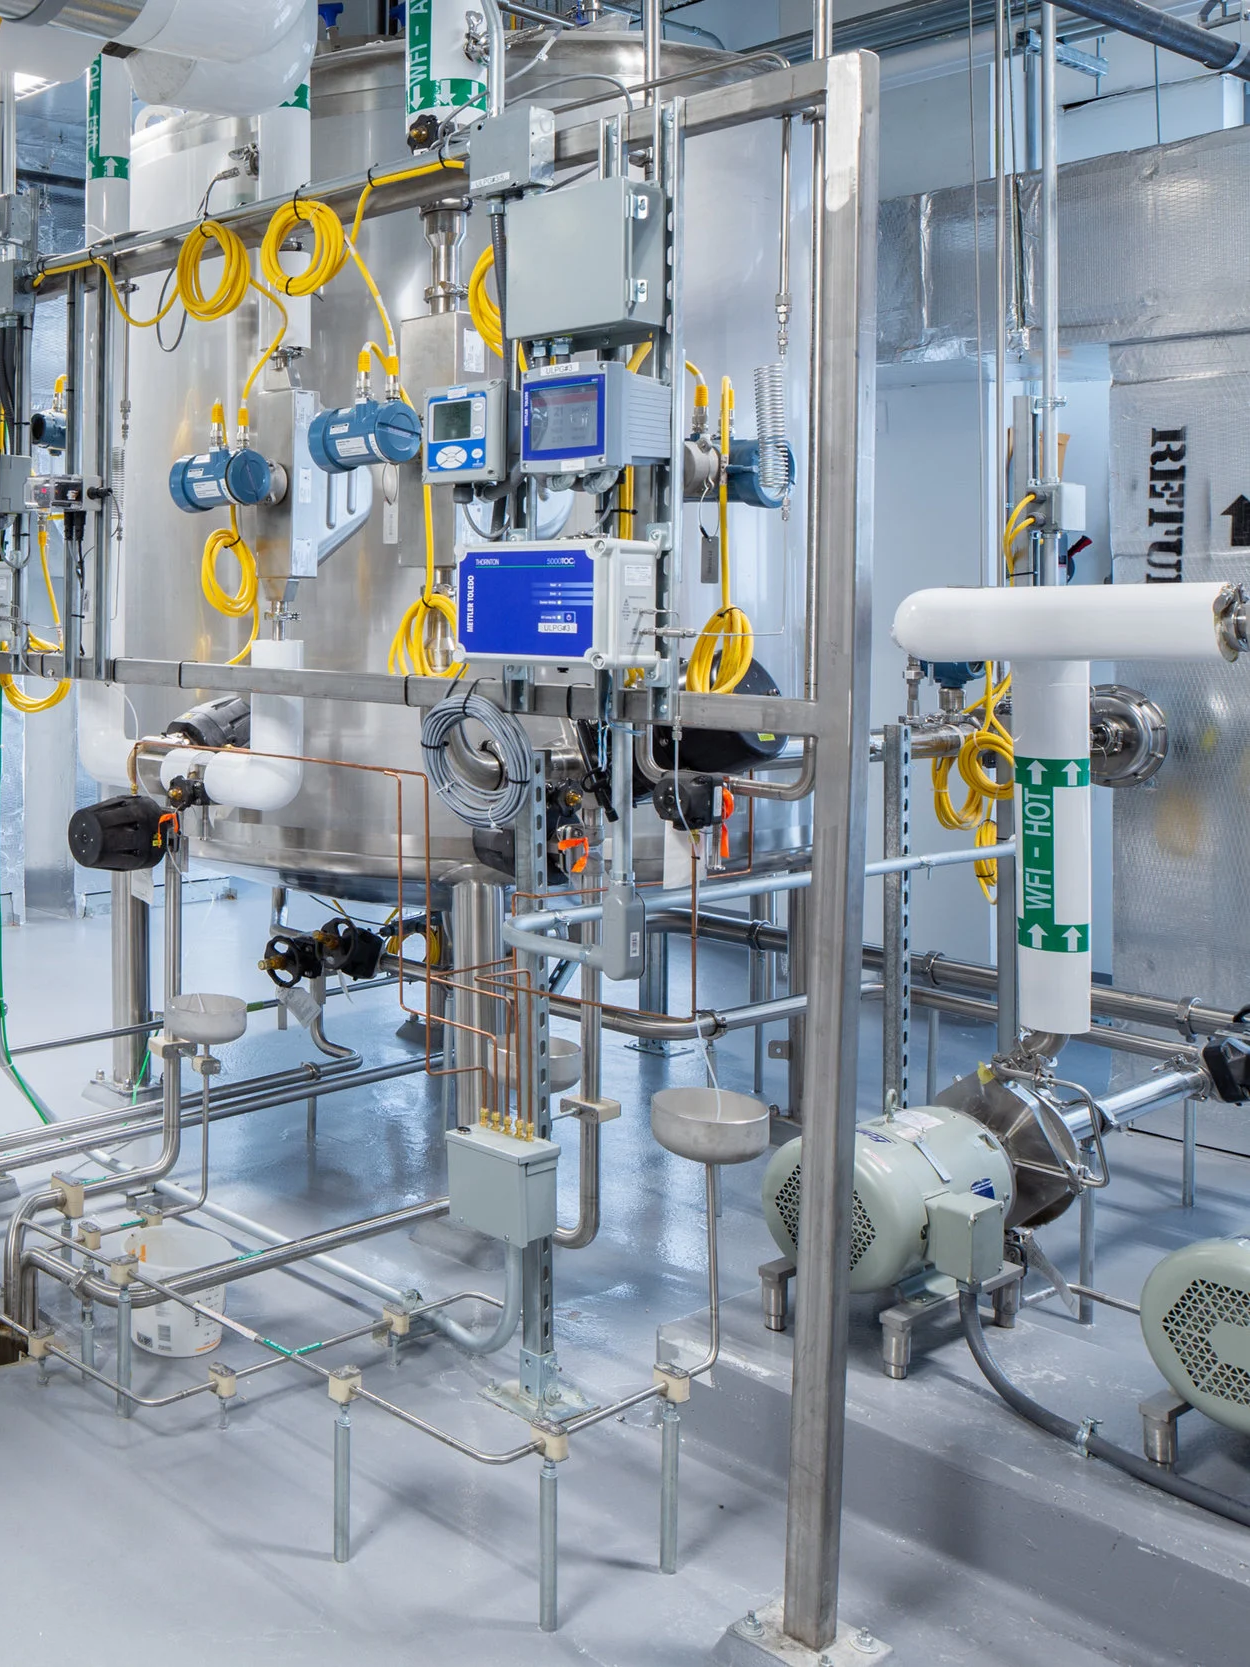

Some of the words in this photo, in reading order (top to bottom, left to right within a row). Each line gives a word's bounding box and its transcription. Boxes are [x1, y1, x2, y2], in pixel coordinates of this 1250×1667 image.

[409, 43, 428, 87] WFI
[475, 558, 500, 566] THORNTON
[466, 604, 474, 633] METTLER
[1024, 787, 1051, 837] HOT
[1025, 867, 1052, 909] WFI
